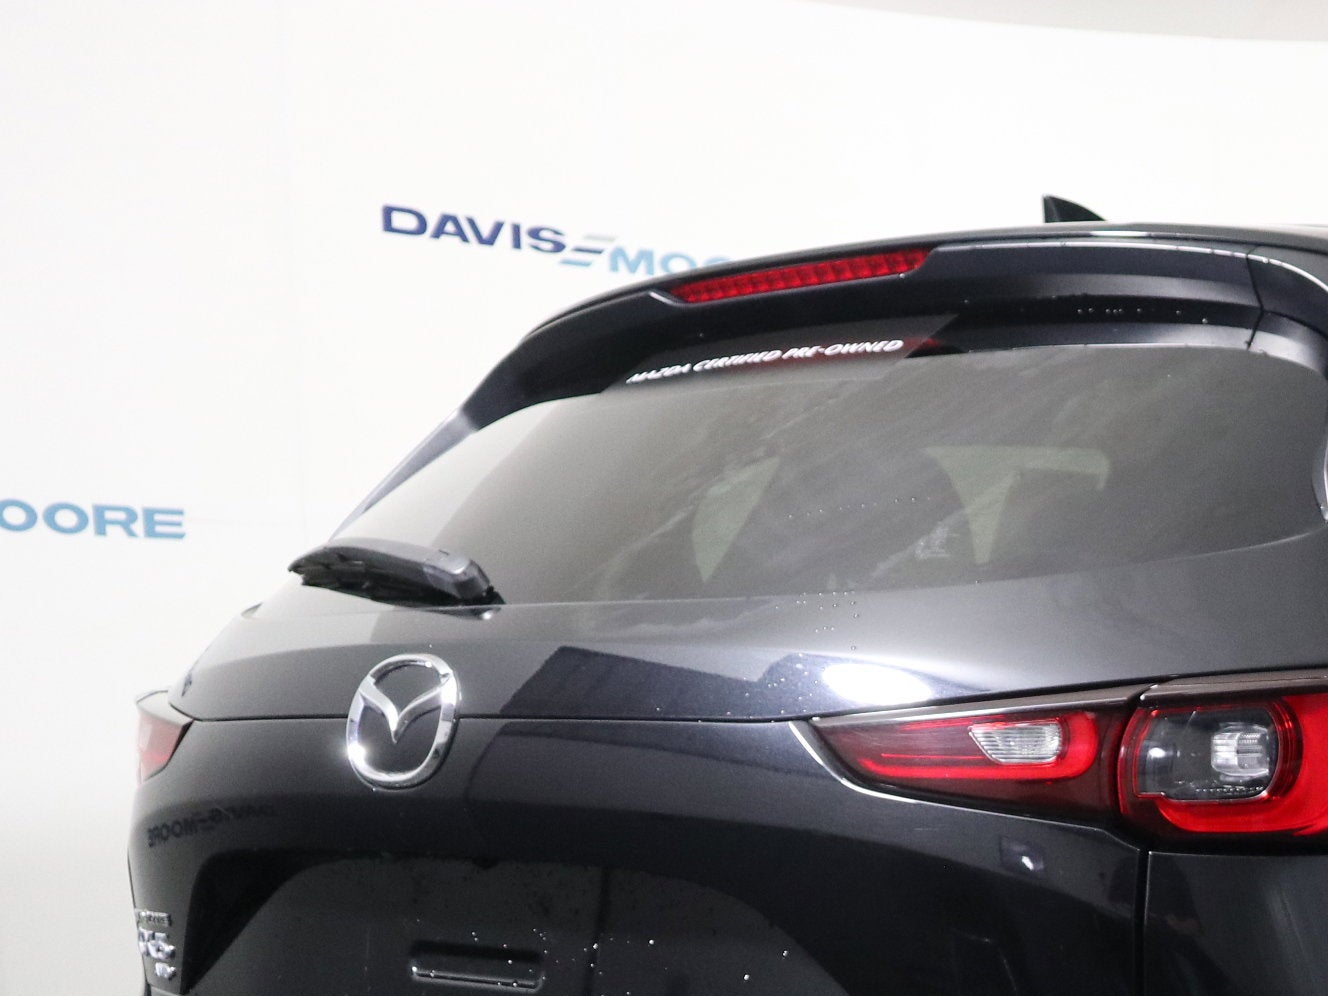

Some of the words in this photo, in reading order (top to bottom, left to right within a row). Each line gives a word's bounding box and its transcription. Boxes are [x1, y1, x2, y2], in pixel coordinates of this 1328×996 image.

[382, 204, 566, 254] DAVIS
[608, 245, 731, 276] MO
[625, 362, 692, 384] MAZDA
[692, 350, 783, 372] CERTIFIED
[781, 339, 905, 360] PRE-OWNED
